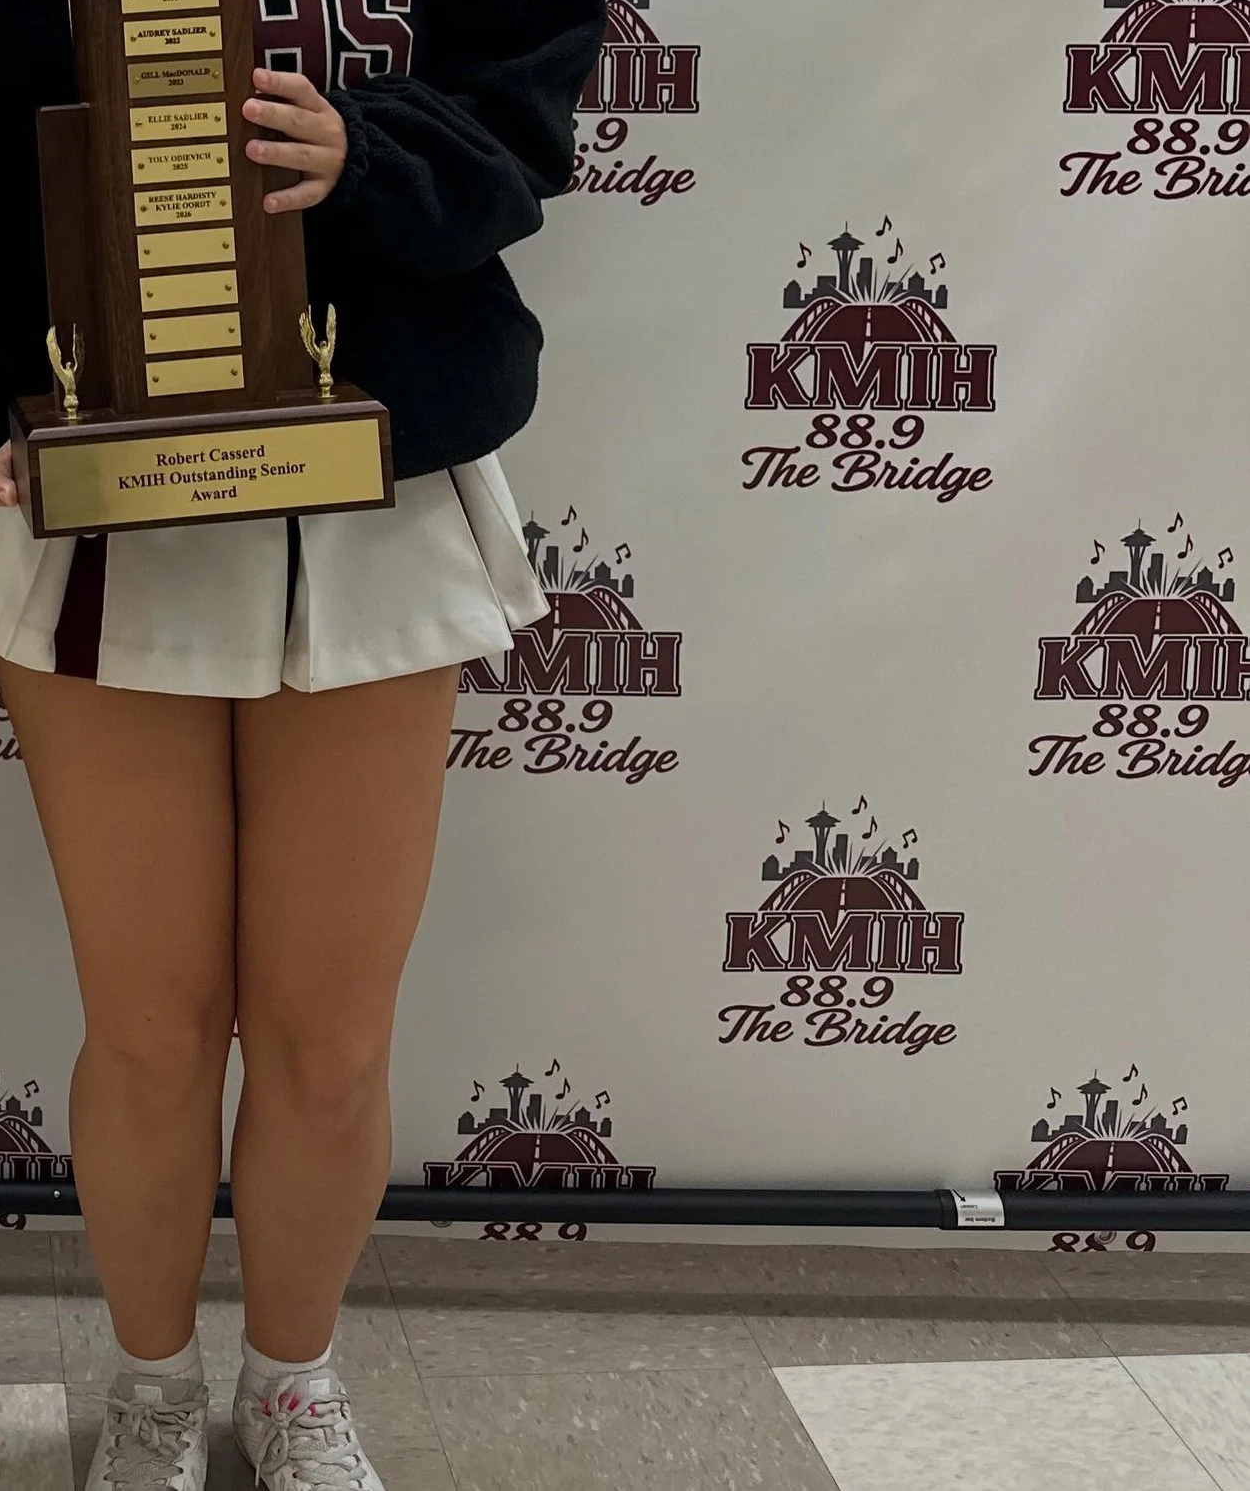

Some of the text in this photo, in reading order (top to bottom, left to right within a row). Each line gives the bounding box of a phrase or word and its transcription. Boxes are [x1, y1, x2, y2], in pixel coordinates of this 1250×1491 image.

[137, 26, 207, 38] AUDREY SADLIER
[165, 37, 181, 45] 2022
[140, 68, 210, 80] GILL MacDONALD
[1063, 44, 1250, 115] KMI
[148, 112, 208, 123] ELLIE SADLIER
[171, 123, 187, 131] 2024
[1127, 118, 1250, 155] 88.9
[1059, 151, 1142, 196] The
[148, 191, 217, 203] REESE HARDISTY
[155, 203, 181, 212] KYLIE
[176, 211, 192, 219] 2026
[744, 343, 997, 412] KMIH
[806, 414, 924, 449] 88.9
[156, 444, 265, 467] Robert Casserd
[118, 461, 306, 490] KMIH Outstanding Senior
[742, 446, 993, 503] The Bridge
[191, 485, 237, 502] Award
[498, 698, 613, 733] 88.9
[1092, 704, 1209, 738] 88.9
[524, 733, 679, 784] Bridge
[1029, 735, 1250, 788] The Bridg
[722, 911, 964, 975] KMIH
[780, 975, 894, 1008] 88.9
[718, 1004, 957, 1056] The Bridge
